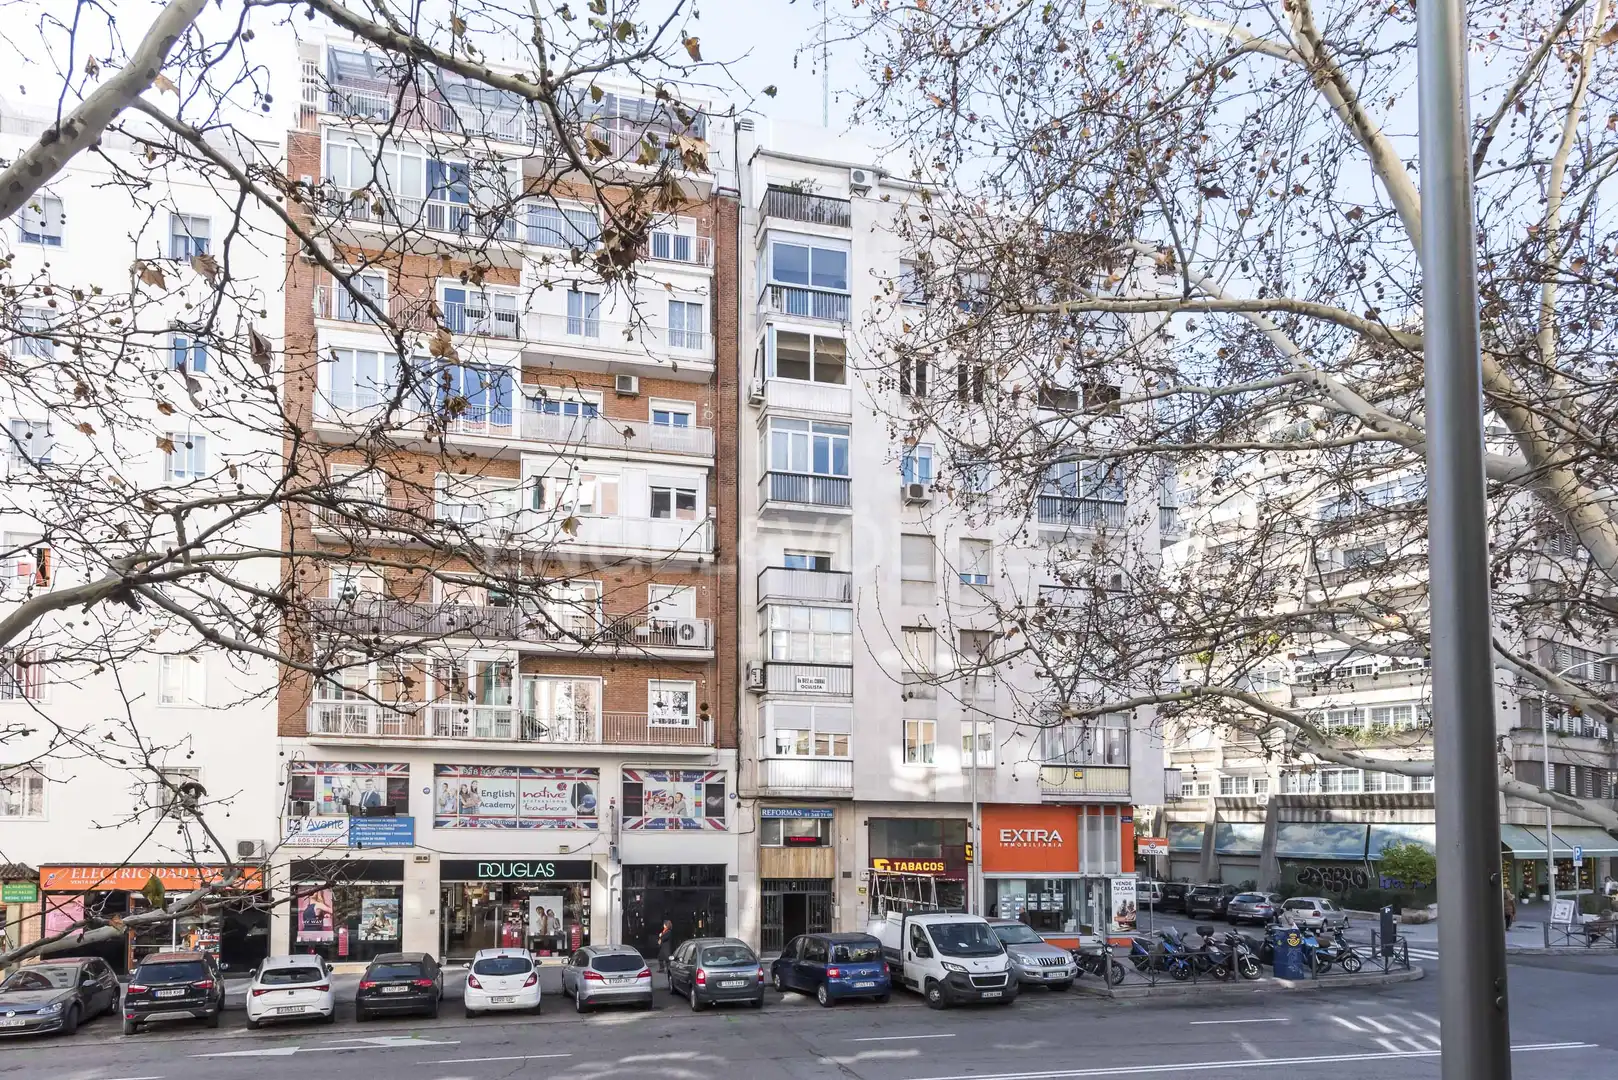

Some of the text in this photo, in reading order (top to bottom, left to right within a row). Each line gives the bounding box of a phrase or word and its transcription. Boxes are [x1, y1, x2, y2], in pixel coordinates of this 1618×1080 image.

[481, 790, 516, 799] English
[523, 786, 566, 798] native
[480, 801, 516, 810] Academy
[306, 819, 344, 831] Avante
[1000, 829, 1063, 842] EXTRA
[1575, 847, 1581, 860] P
[478, 862, 555, 877] DOUGLAS
[894, 862, 944, 871] TABACOS
[71, 867, 189, 879] ELECTRICIDAD
